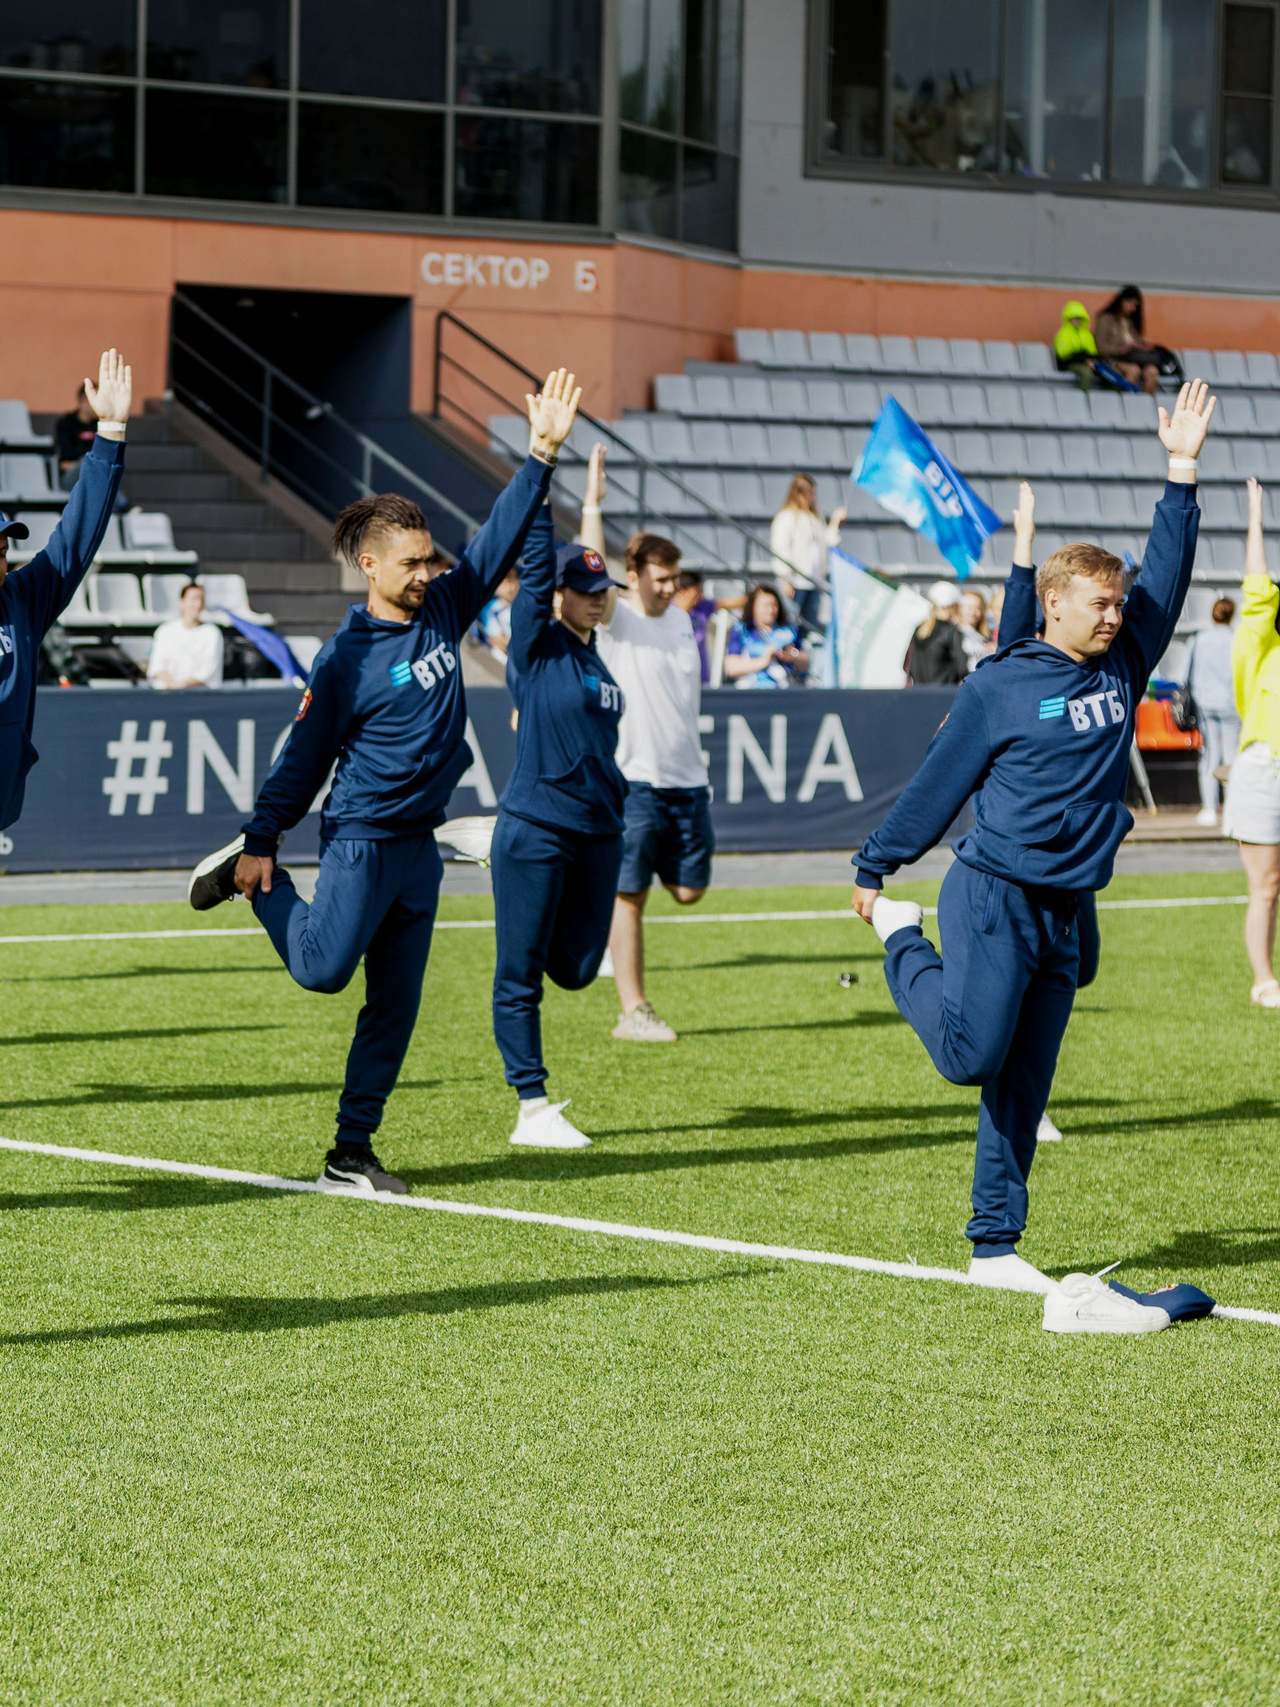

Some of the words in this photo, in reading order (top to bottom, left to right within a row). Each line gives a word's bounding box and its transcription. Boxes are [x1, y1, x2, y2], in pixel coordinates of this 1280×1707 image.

[421, 251, 551, 289] СЕКТОР
[574, 260, 598, 293] Б
[410, 641, 456, 691] ВТБ
[600, 681, 625, 713] ВТ
[1067, 689, 1125, 732] ВТБ
